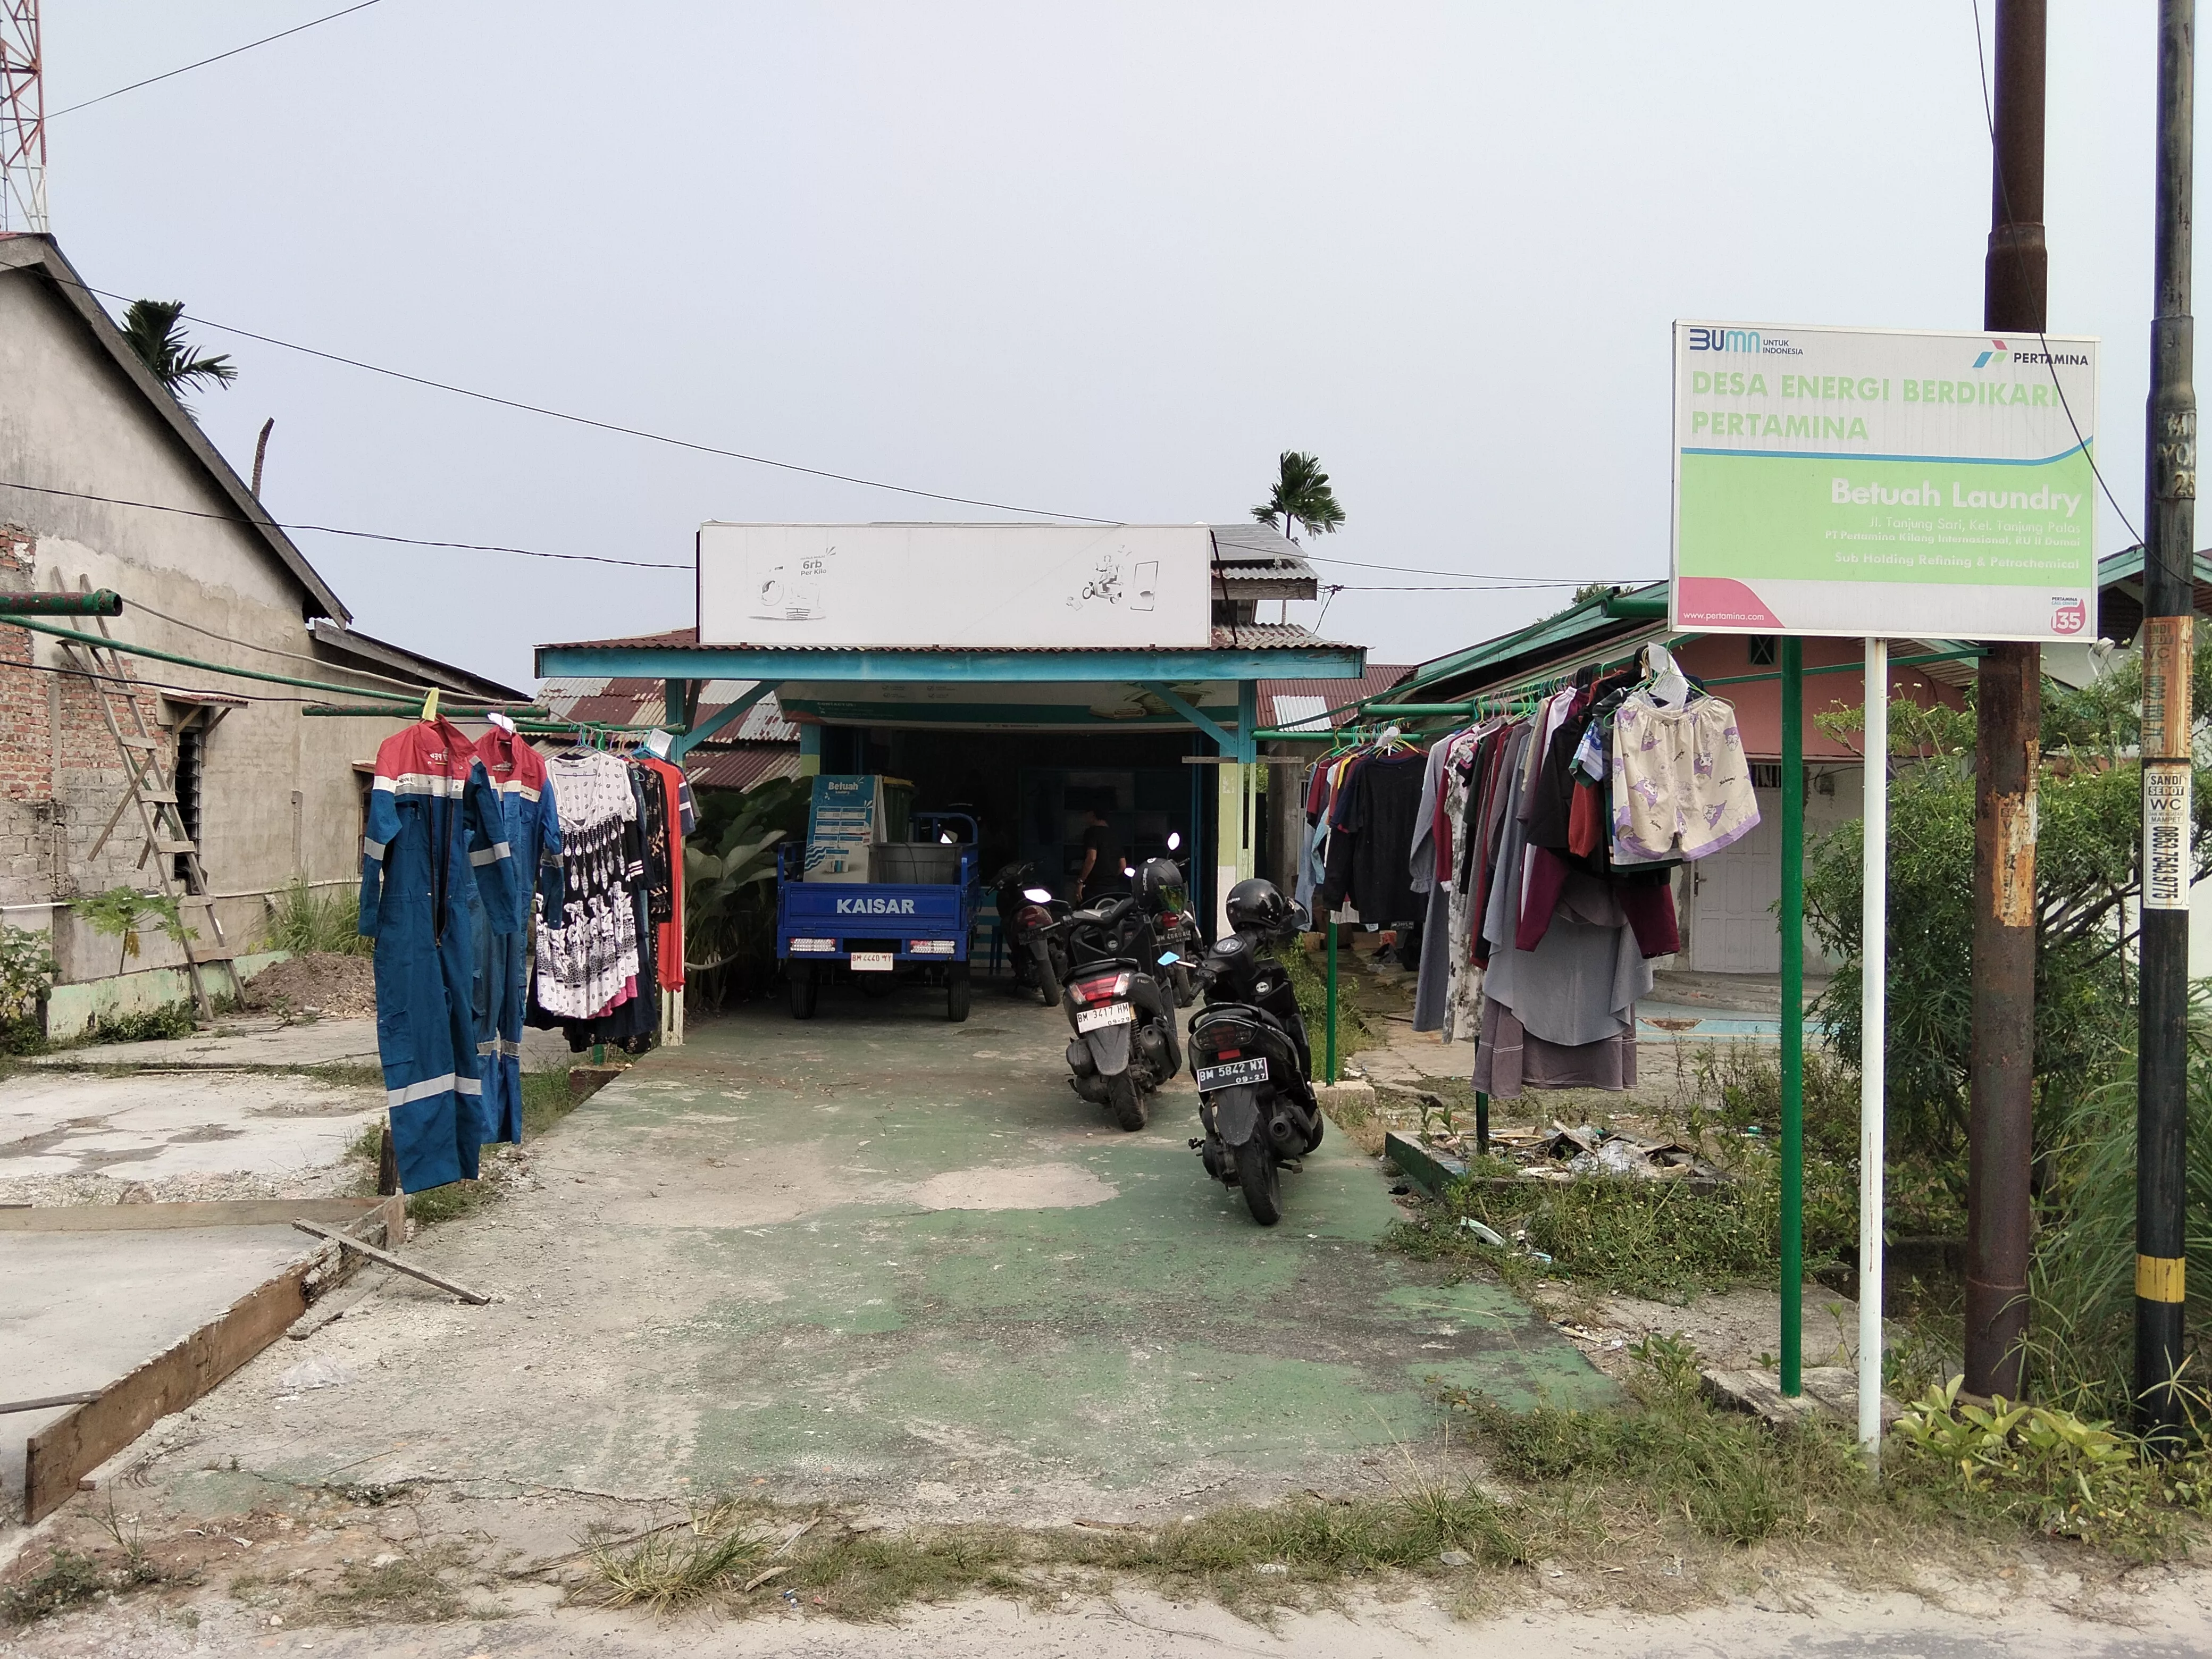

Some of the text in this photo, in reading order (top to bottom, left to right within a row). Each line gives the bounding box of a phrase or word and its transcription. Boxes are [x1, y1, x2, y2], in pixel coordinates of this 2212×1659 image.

[2014, 353, 2088, 366] PERTAMINA
[1692, 371, 2058, 407] DESA ENERGI BERDIKARI
[1692, 411, 1869, 440] PERTAMINA
[1832, 477, 2082, 518] Betuah Laundry
[1870, 517, 2080, 534] Jl. Tanjung Sari, Kel. Tanjung Palas
[1840, 532, 1895, 541] Pertamina
[1899, 533, 1934, 544] Kilang
[1938, 534, 2011, 546] Internasional,
[2016, 537, 2030, 545] RU
[2046, 537, 2080, 546] Dumai
[803, 559, 822, 569] 6rb
[1836, 552, 2079, 569] Sub Holding Refining & Petrochemical
[1683, 612, 1764, 621] www.pertamina.com
[2053, 612, 2081, 629] 135
[2151, 776, 2181, 785] SANDI
[2150, 799, 2181, 810] WC
[837, 899, 915, 914] KAISAR
[1078, 1003, 1128, 1023] BM 3417 HM
[1108, 1017, 1130, 1025] 09-29
[1200, 1060, 1264, 1082] BM 5842 NX
[1236, 1074, 1265, 1083] 09-27
